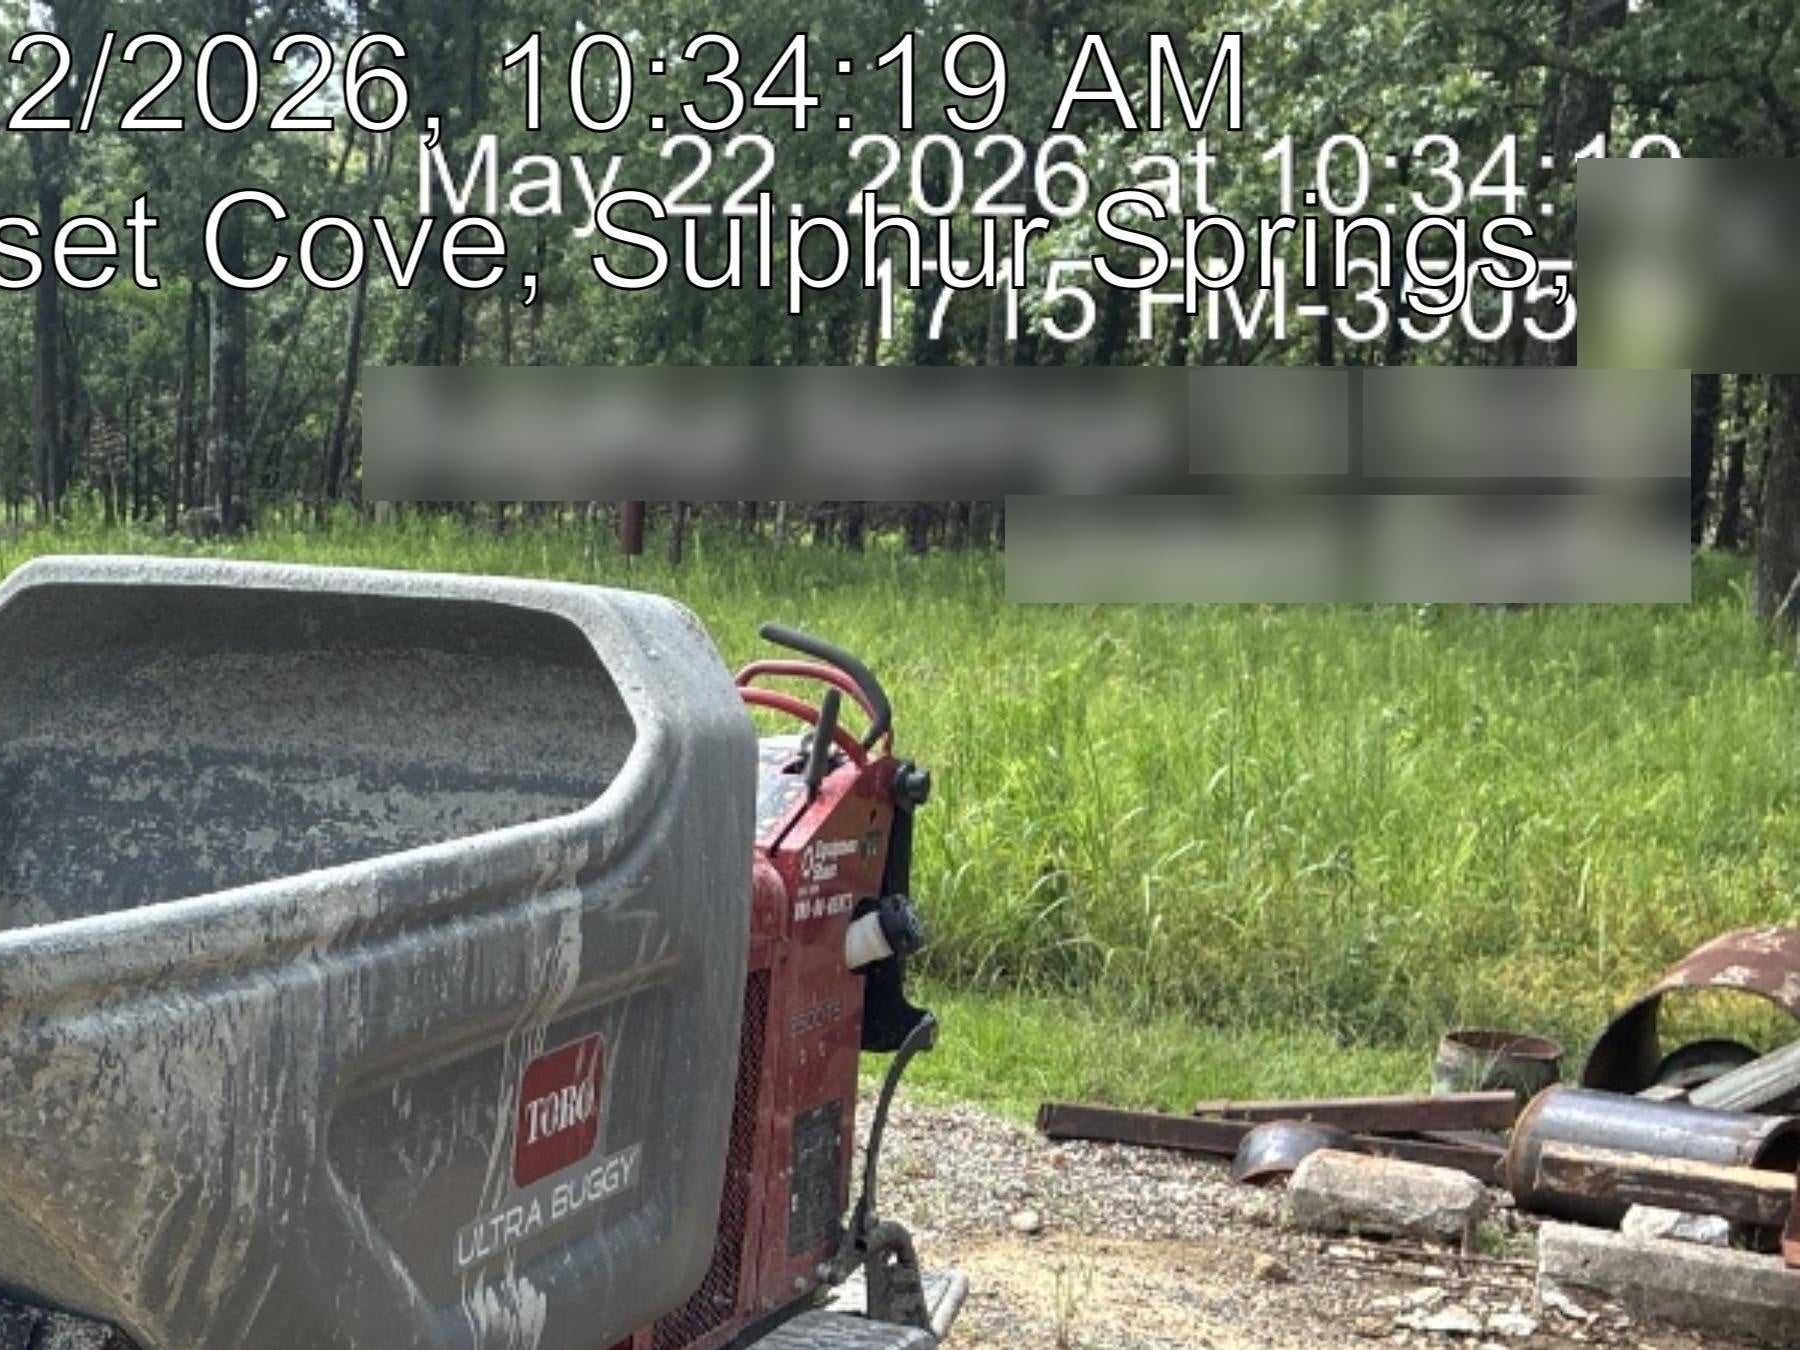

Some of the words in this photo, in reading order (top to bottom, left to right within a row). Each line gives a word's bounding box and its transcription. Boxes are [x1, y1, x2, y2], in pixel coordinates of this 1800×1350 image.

[524, 1079, 596, 1144] TORO
[456, 1197, 543, 1266] ULTRA
[550, 1149, 636, 1219] BUGGY
